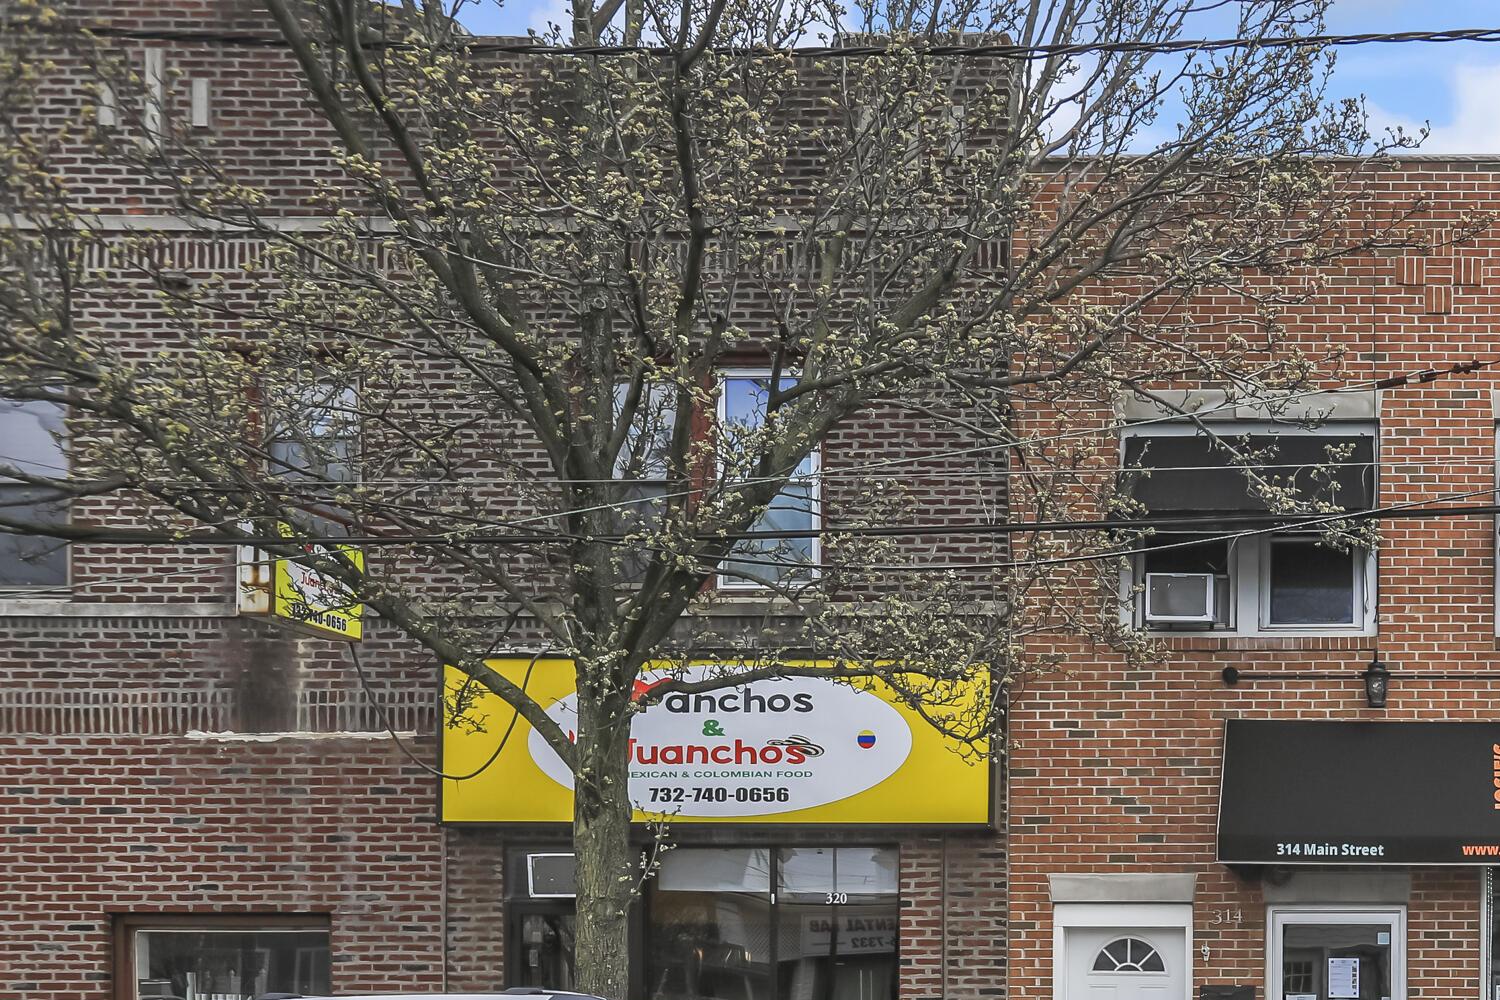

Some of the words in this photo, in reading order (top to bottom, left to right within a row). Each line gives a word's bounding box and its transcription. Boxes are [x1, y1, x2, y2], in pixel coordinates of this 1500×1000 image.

[702, 719, 726, 737] &
[628, 770, 678, 779] EXICAN
[682, 770, 691, 779] &
[694, 770, 773, 779] COLOMBIAN
[776, 770, 813, 778] FOOD
[649, 787, 790, 803] 732-740-0656
[1276, 843, 1301, 856] 314
[1304, 843, 1338, 856] Main
[1341, 844, 1384, 856] Street
[825, 893, 848, 905] 320
[1209, 909, 1243, 924] 314
